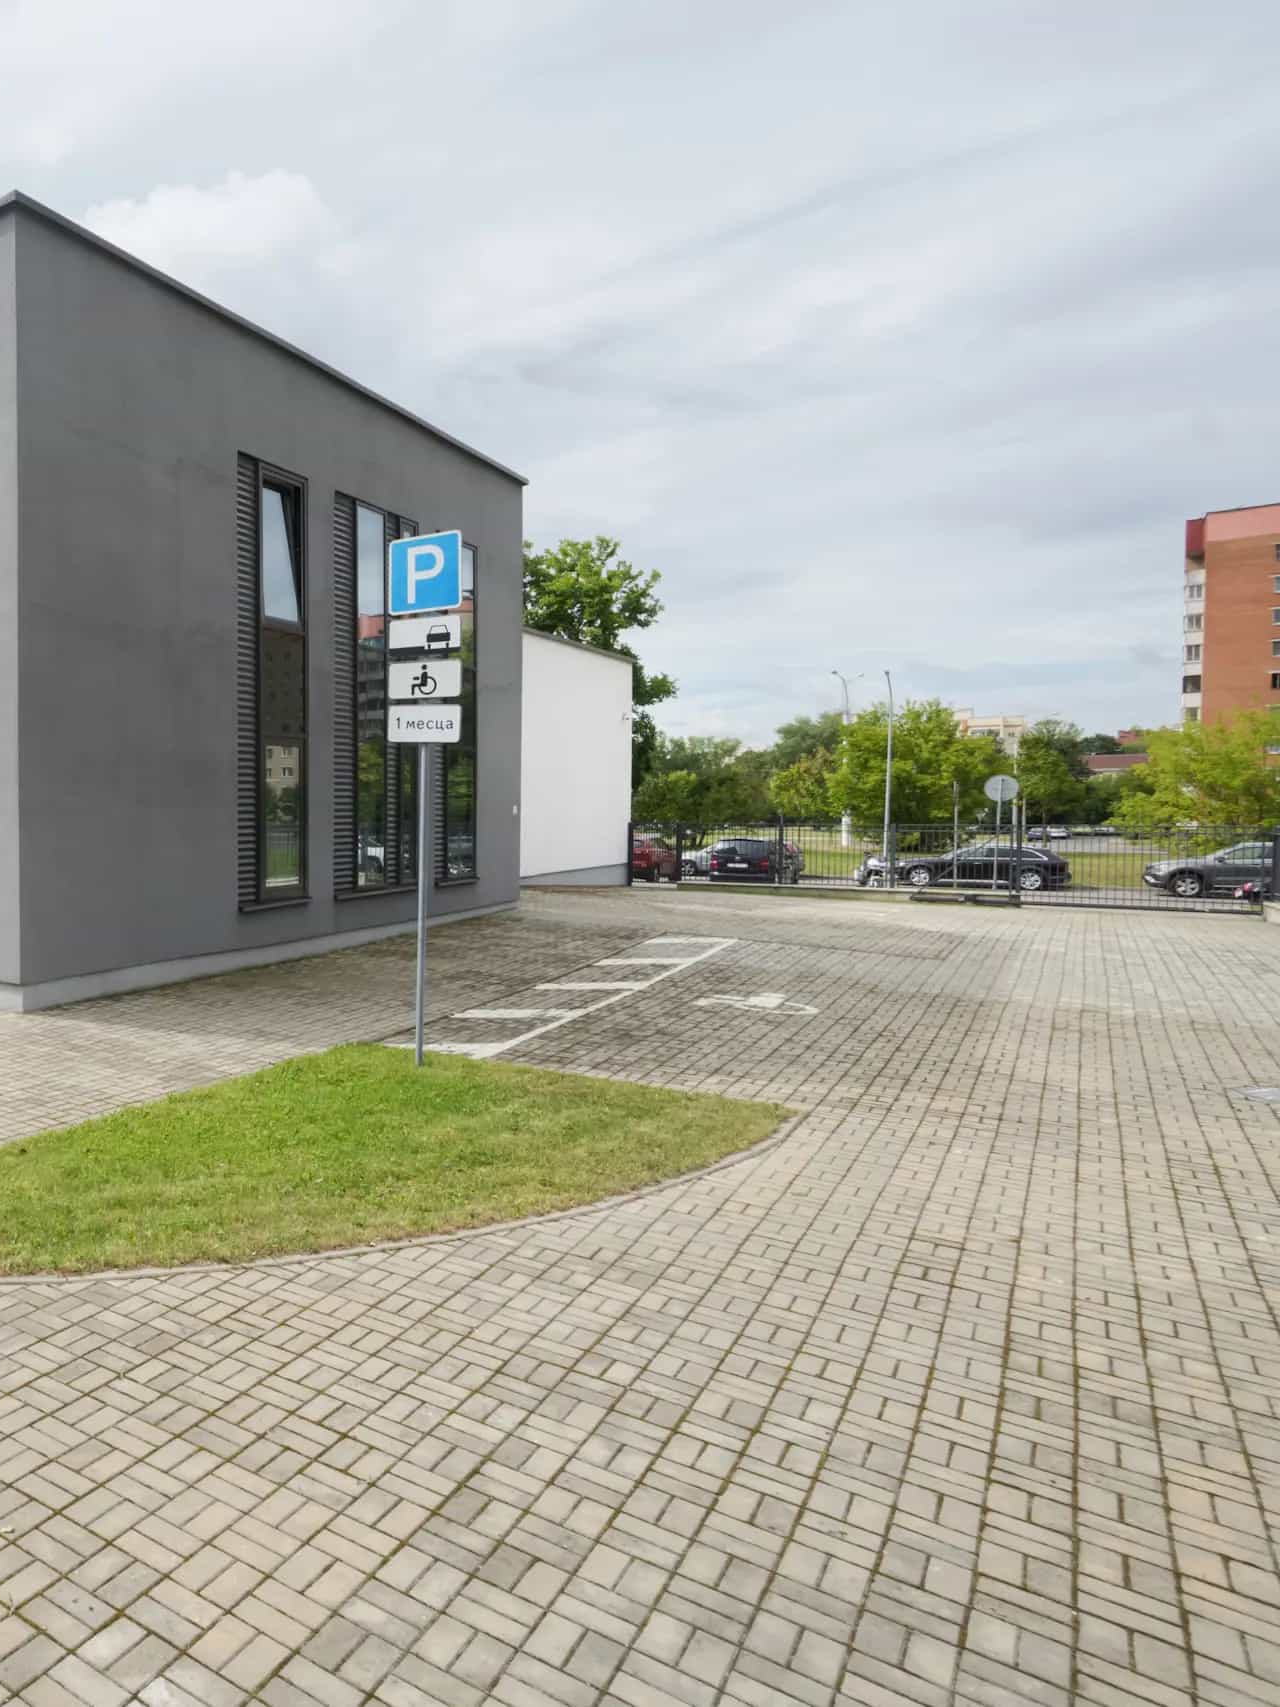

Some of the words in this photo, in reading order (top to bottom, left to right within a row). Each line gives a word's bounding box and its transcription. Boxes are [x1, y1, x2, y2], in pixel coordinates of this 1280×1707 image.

[407, 543, 445, 605] P
[395, 716, 401, 729] 1
[406, 719, 454, 731] месца
